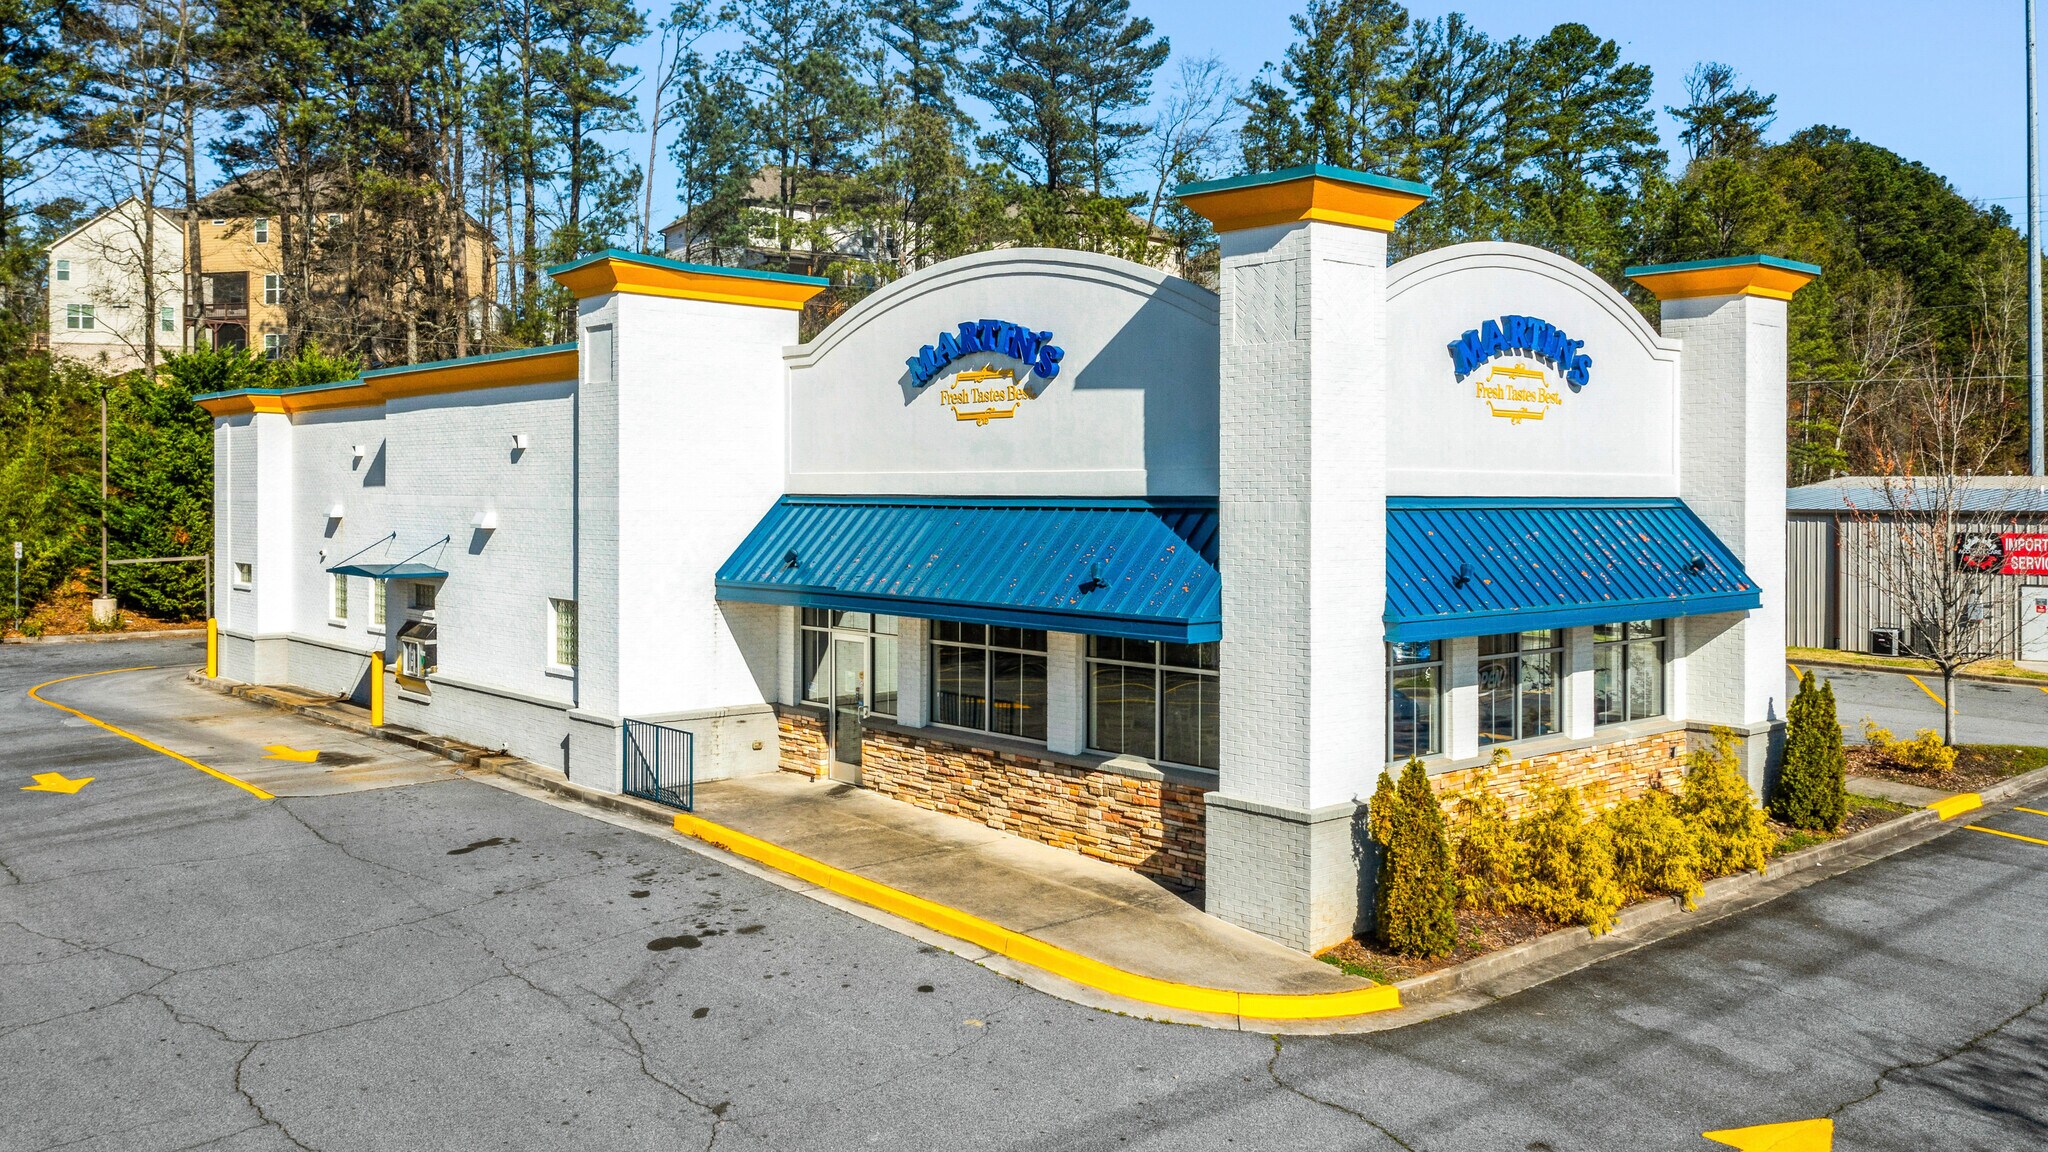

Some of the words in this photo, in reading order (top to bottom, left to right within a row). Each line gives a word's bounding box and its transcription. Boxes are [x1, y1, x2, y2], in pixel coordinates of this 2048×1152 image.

[906, 319, 1065, 388] MARTIN'S
[1447, 315, 1593, 386] MARTIN'S
[940, 389, 969, 406] Fresh
[970, 386, 1006, 404] Tastes
[1476, 382, 1504, 399] Fresh
[1506, 385, 1536, 403] Tastes
